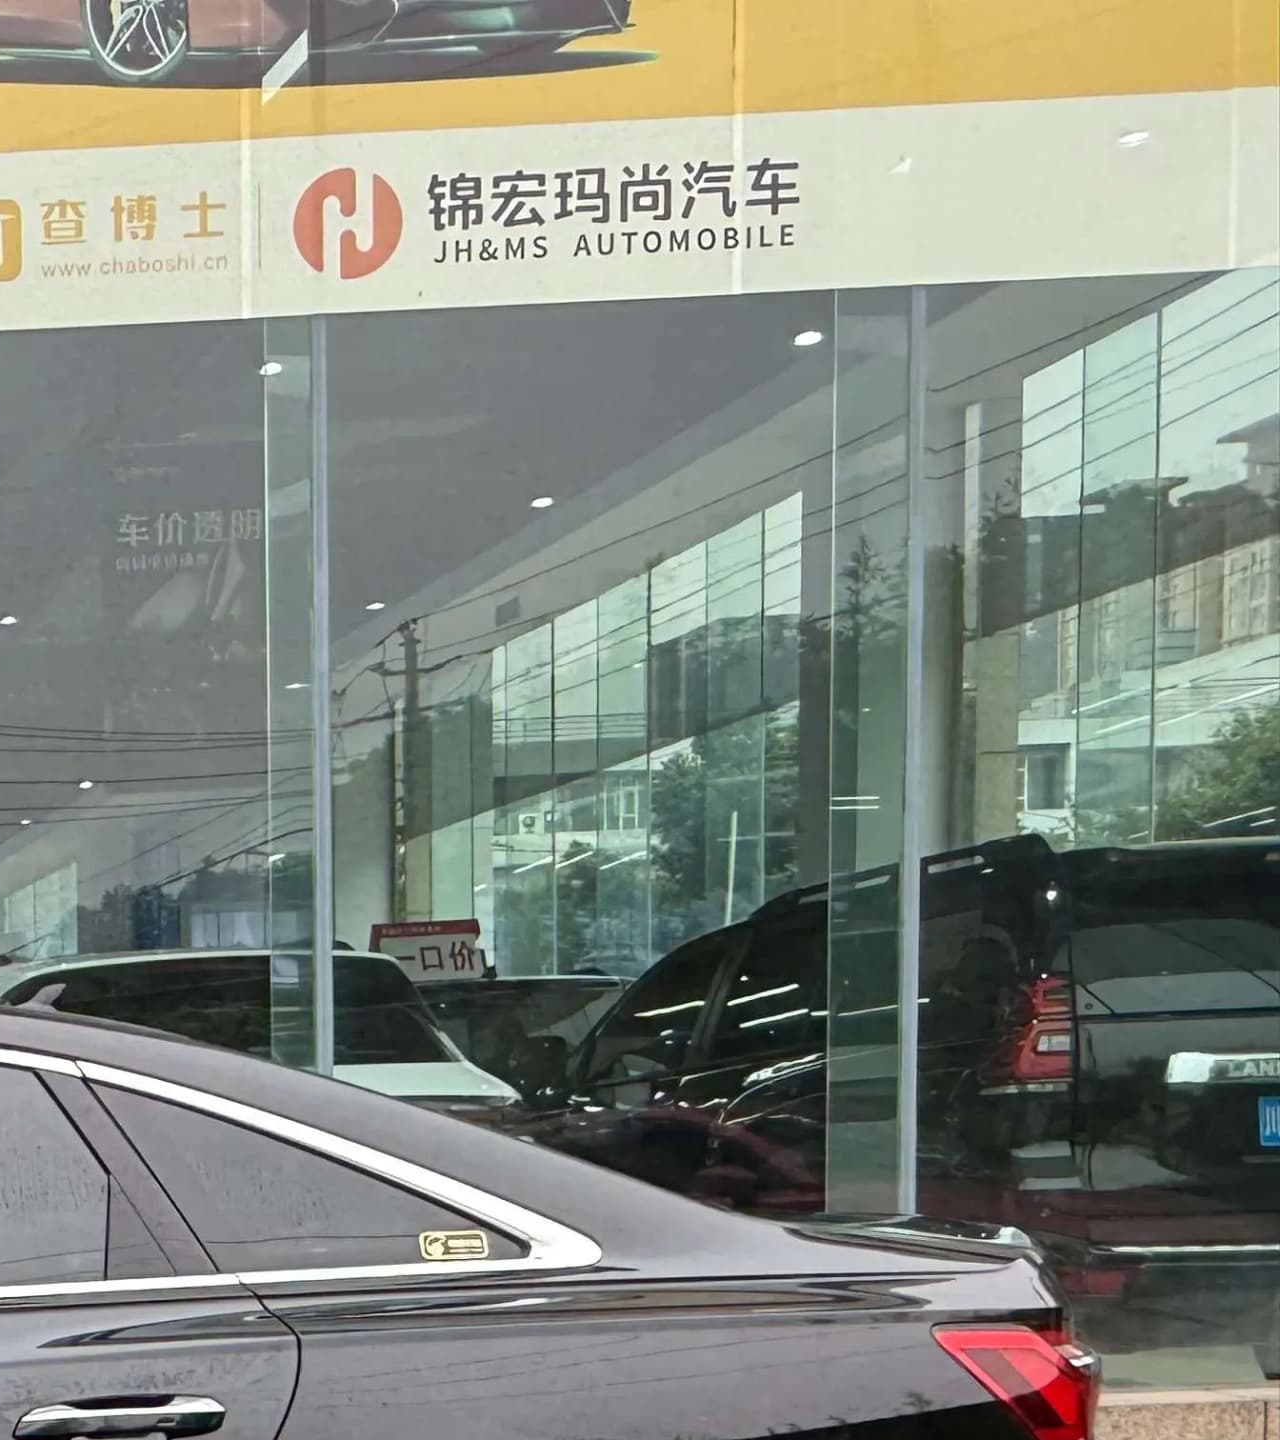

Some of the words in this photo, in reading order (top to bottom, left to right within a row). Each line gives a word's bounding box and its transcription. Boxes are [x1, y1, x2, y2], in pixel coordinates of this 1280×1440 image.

[428, 158, 800, 231] 锦宏玛尚汽车
[40, 190, 228, 246] 查博士
[434, 235, 549, 264] JH&MS
[573, 223, 797, 258] AUTOMOBILE
[41, 251, 229, 279] www.chaboshi.cn
[394, 940, 476, 971] 一口价
